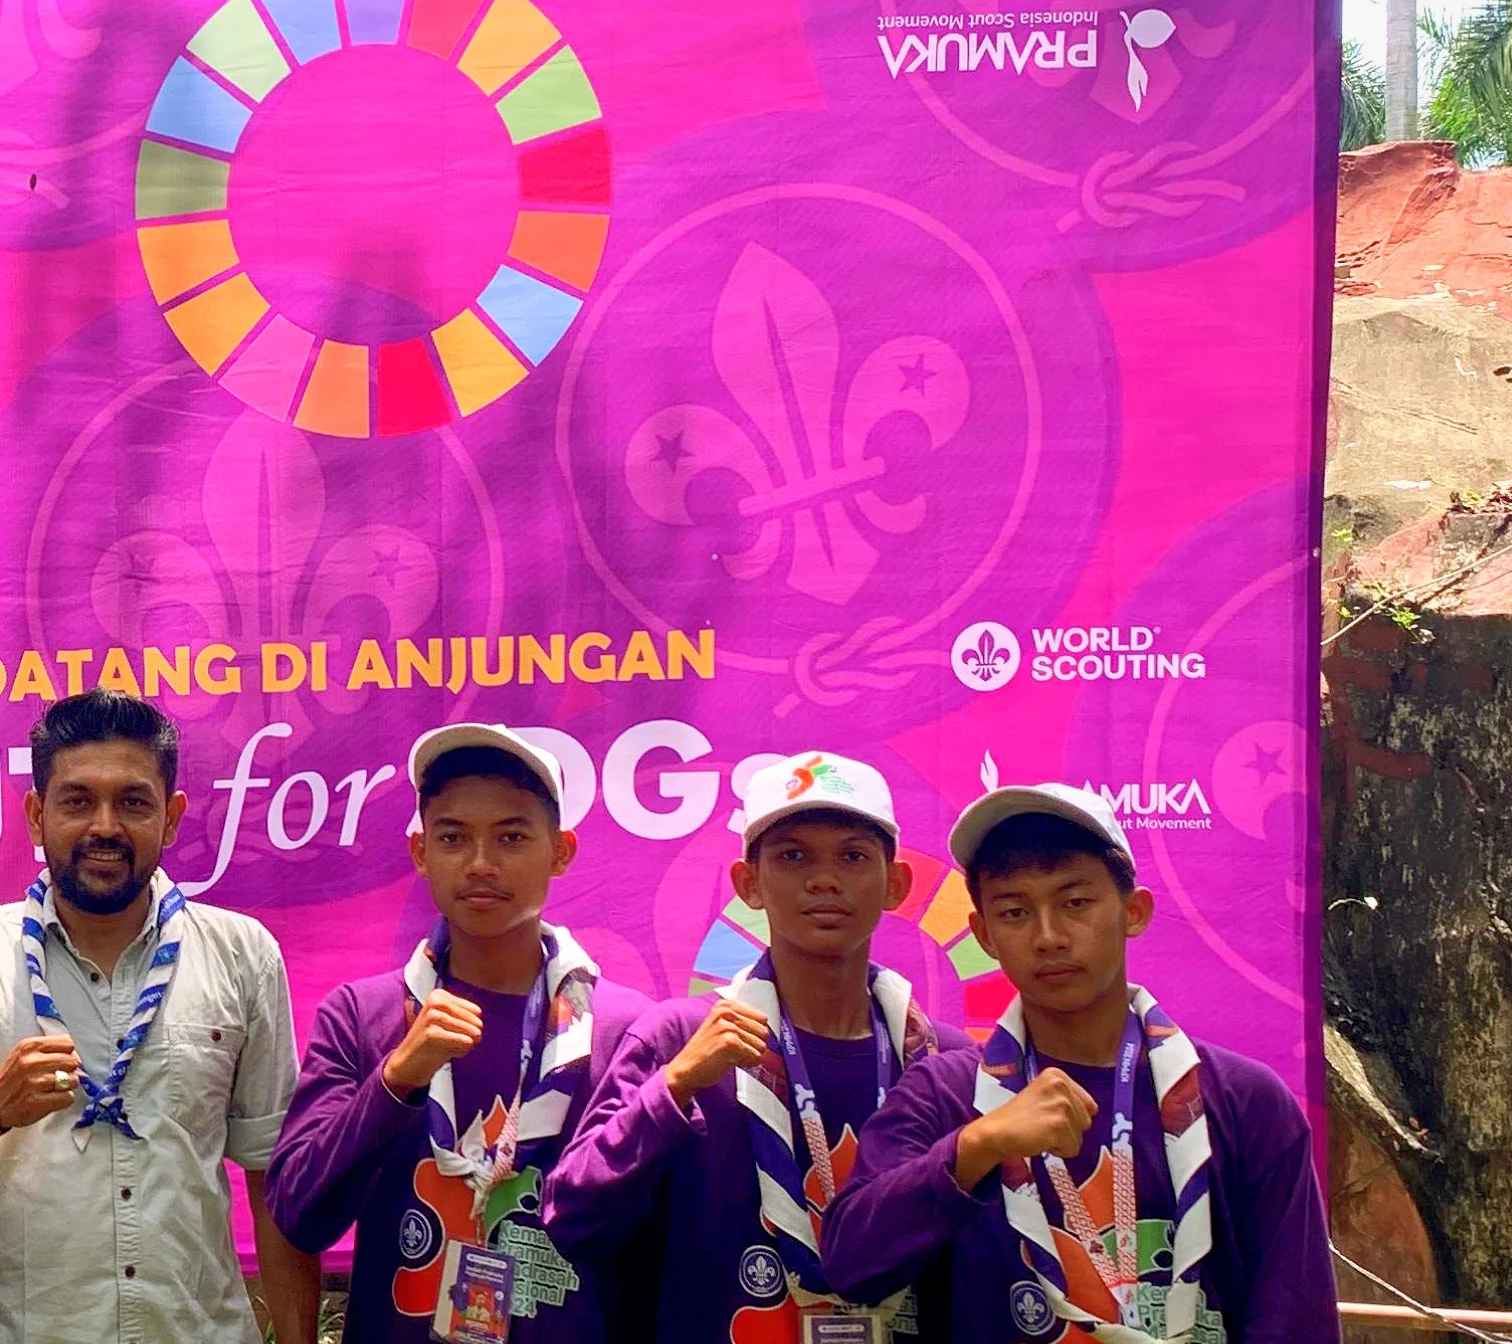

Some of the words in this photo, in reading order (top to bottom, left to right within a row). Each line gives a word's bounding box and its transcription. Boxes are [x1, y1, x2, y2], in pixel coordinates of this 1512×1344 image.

[877, 13, 964, 31] Movement
[967, 11, 1015, 29] Scout
[1019, 10, 1099, 27] Indonesia
[877, 29, 1097, 80] PRAMUKA
[1031, 626, 1154, 653] WORLD
[261, 640, 327, 693] DI
[346, 628, 716, 695] ANJUNGAN
[1031, 653, 1207, 681] SCOUTING
[176, 722, 396, 898] for
[1136, 816, 1212, 831] Movement
[514, 1283, 564, 1308] sional
